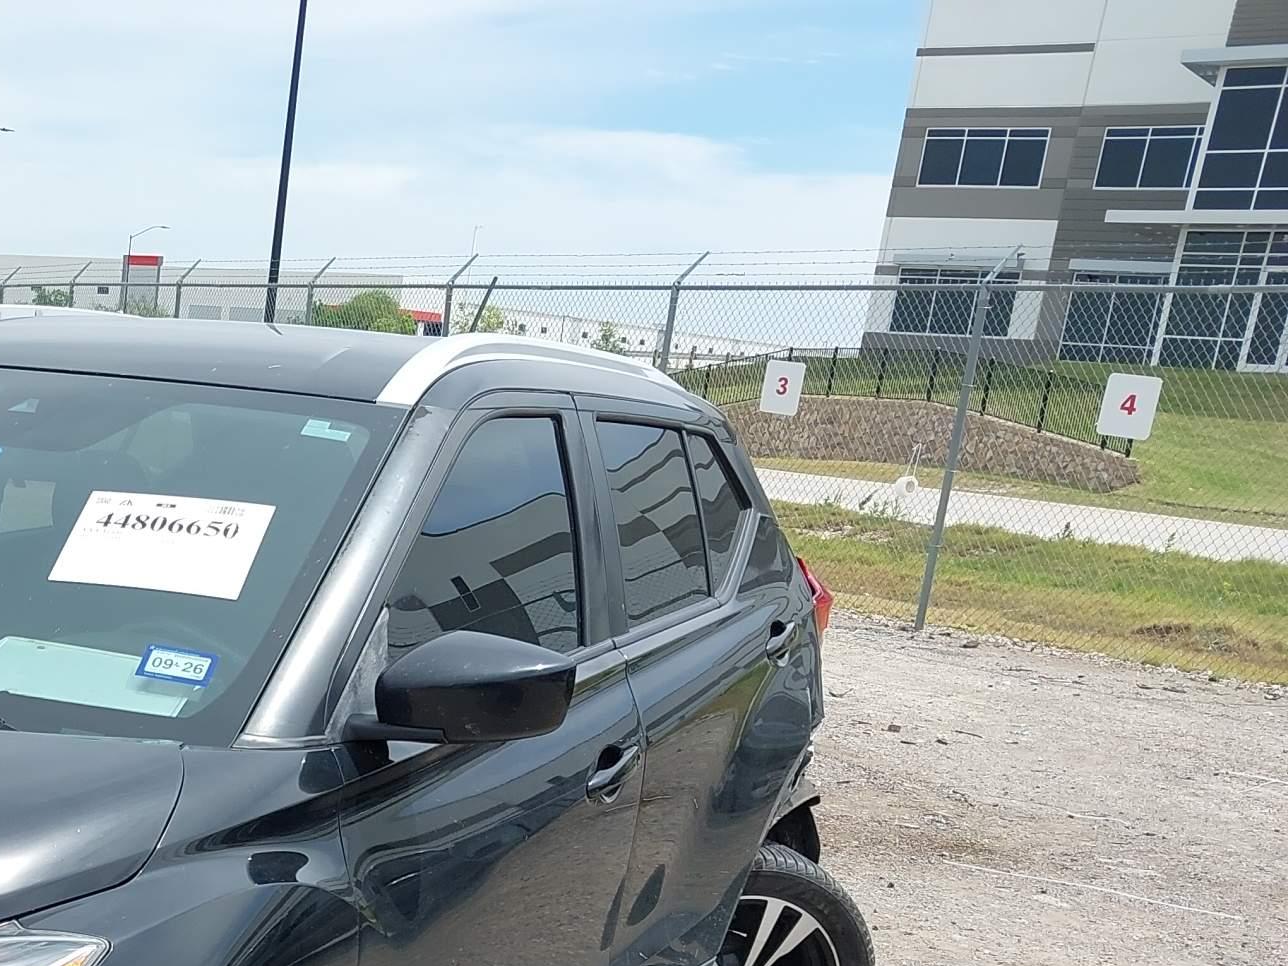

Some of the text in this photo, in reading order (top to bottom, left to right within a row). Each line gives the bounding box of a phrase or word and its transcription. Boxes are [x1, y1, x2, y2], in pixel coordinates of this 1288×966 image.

[776, 377, 788, 395] 3
[1120, 394, 1137, 415] 4
[95, 512, 240, 540] 44806650
